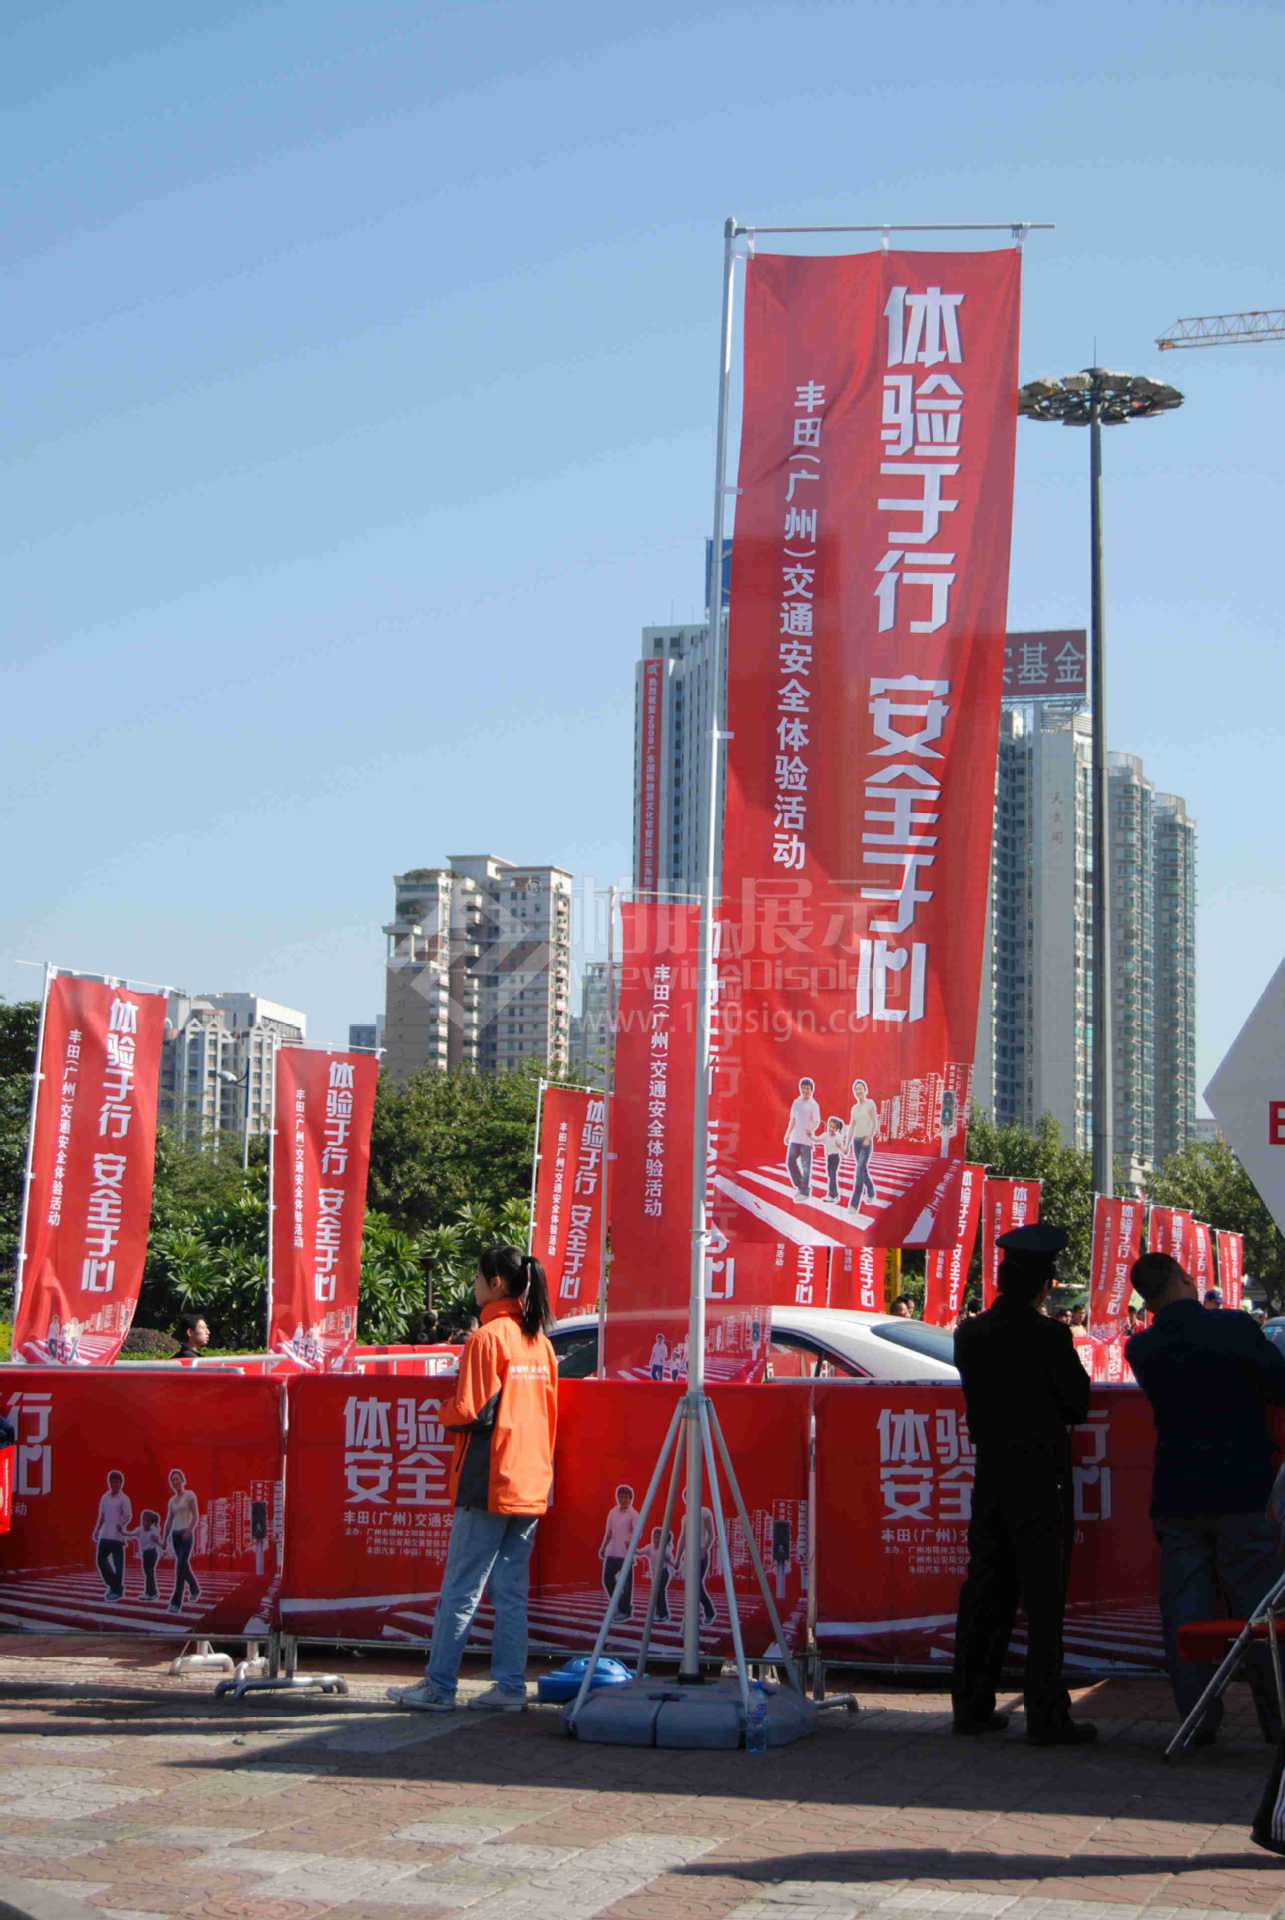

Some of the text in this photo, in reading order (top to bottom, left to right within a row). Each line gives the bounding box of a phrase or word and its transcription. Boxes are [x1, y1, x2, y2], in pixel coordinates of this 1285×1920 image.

[772, 380, 826, 870] 丰田（广州）交通安全体验活动
[855, 285, 967, 1023] 体验于行 安全于心
[80, 997, 140, 1293] 体验于行 安全于心
[314, 1060, 355, 1302] 体验于行 安全于心
[643, 963, 671, 1218] 丰田（广州）交通安全体验活动
[559, 1203, 593, 1300] 安全于心
[343, 1395, 455, 1451] 体验
[343, 1450, 451, 1506] 安全
